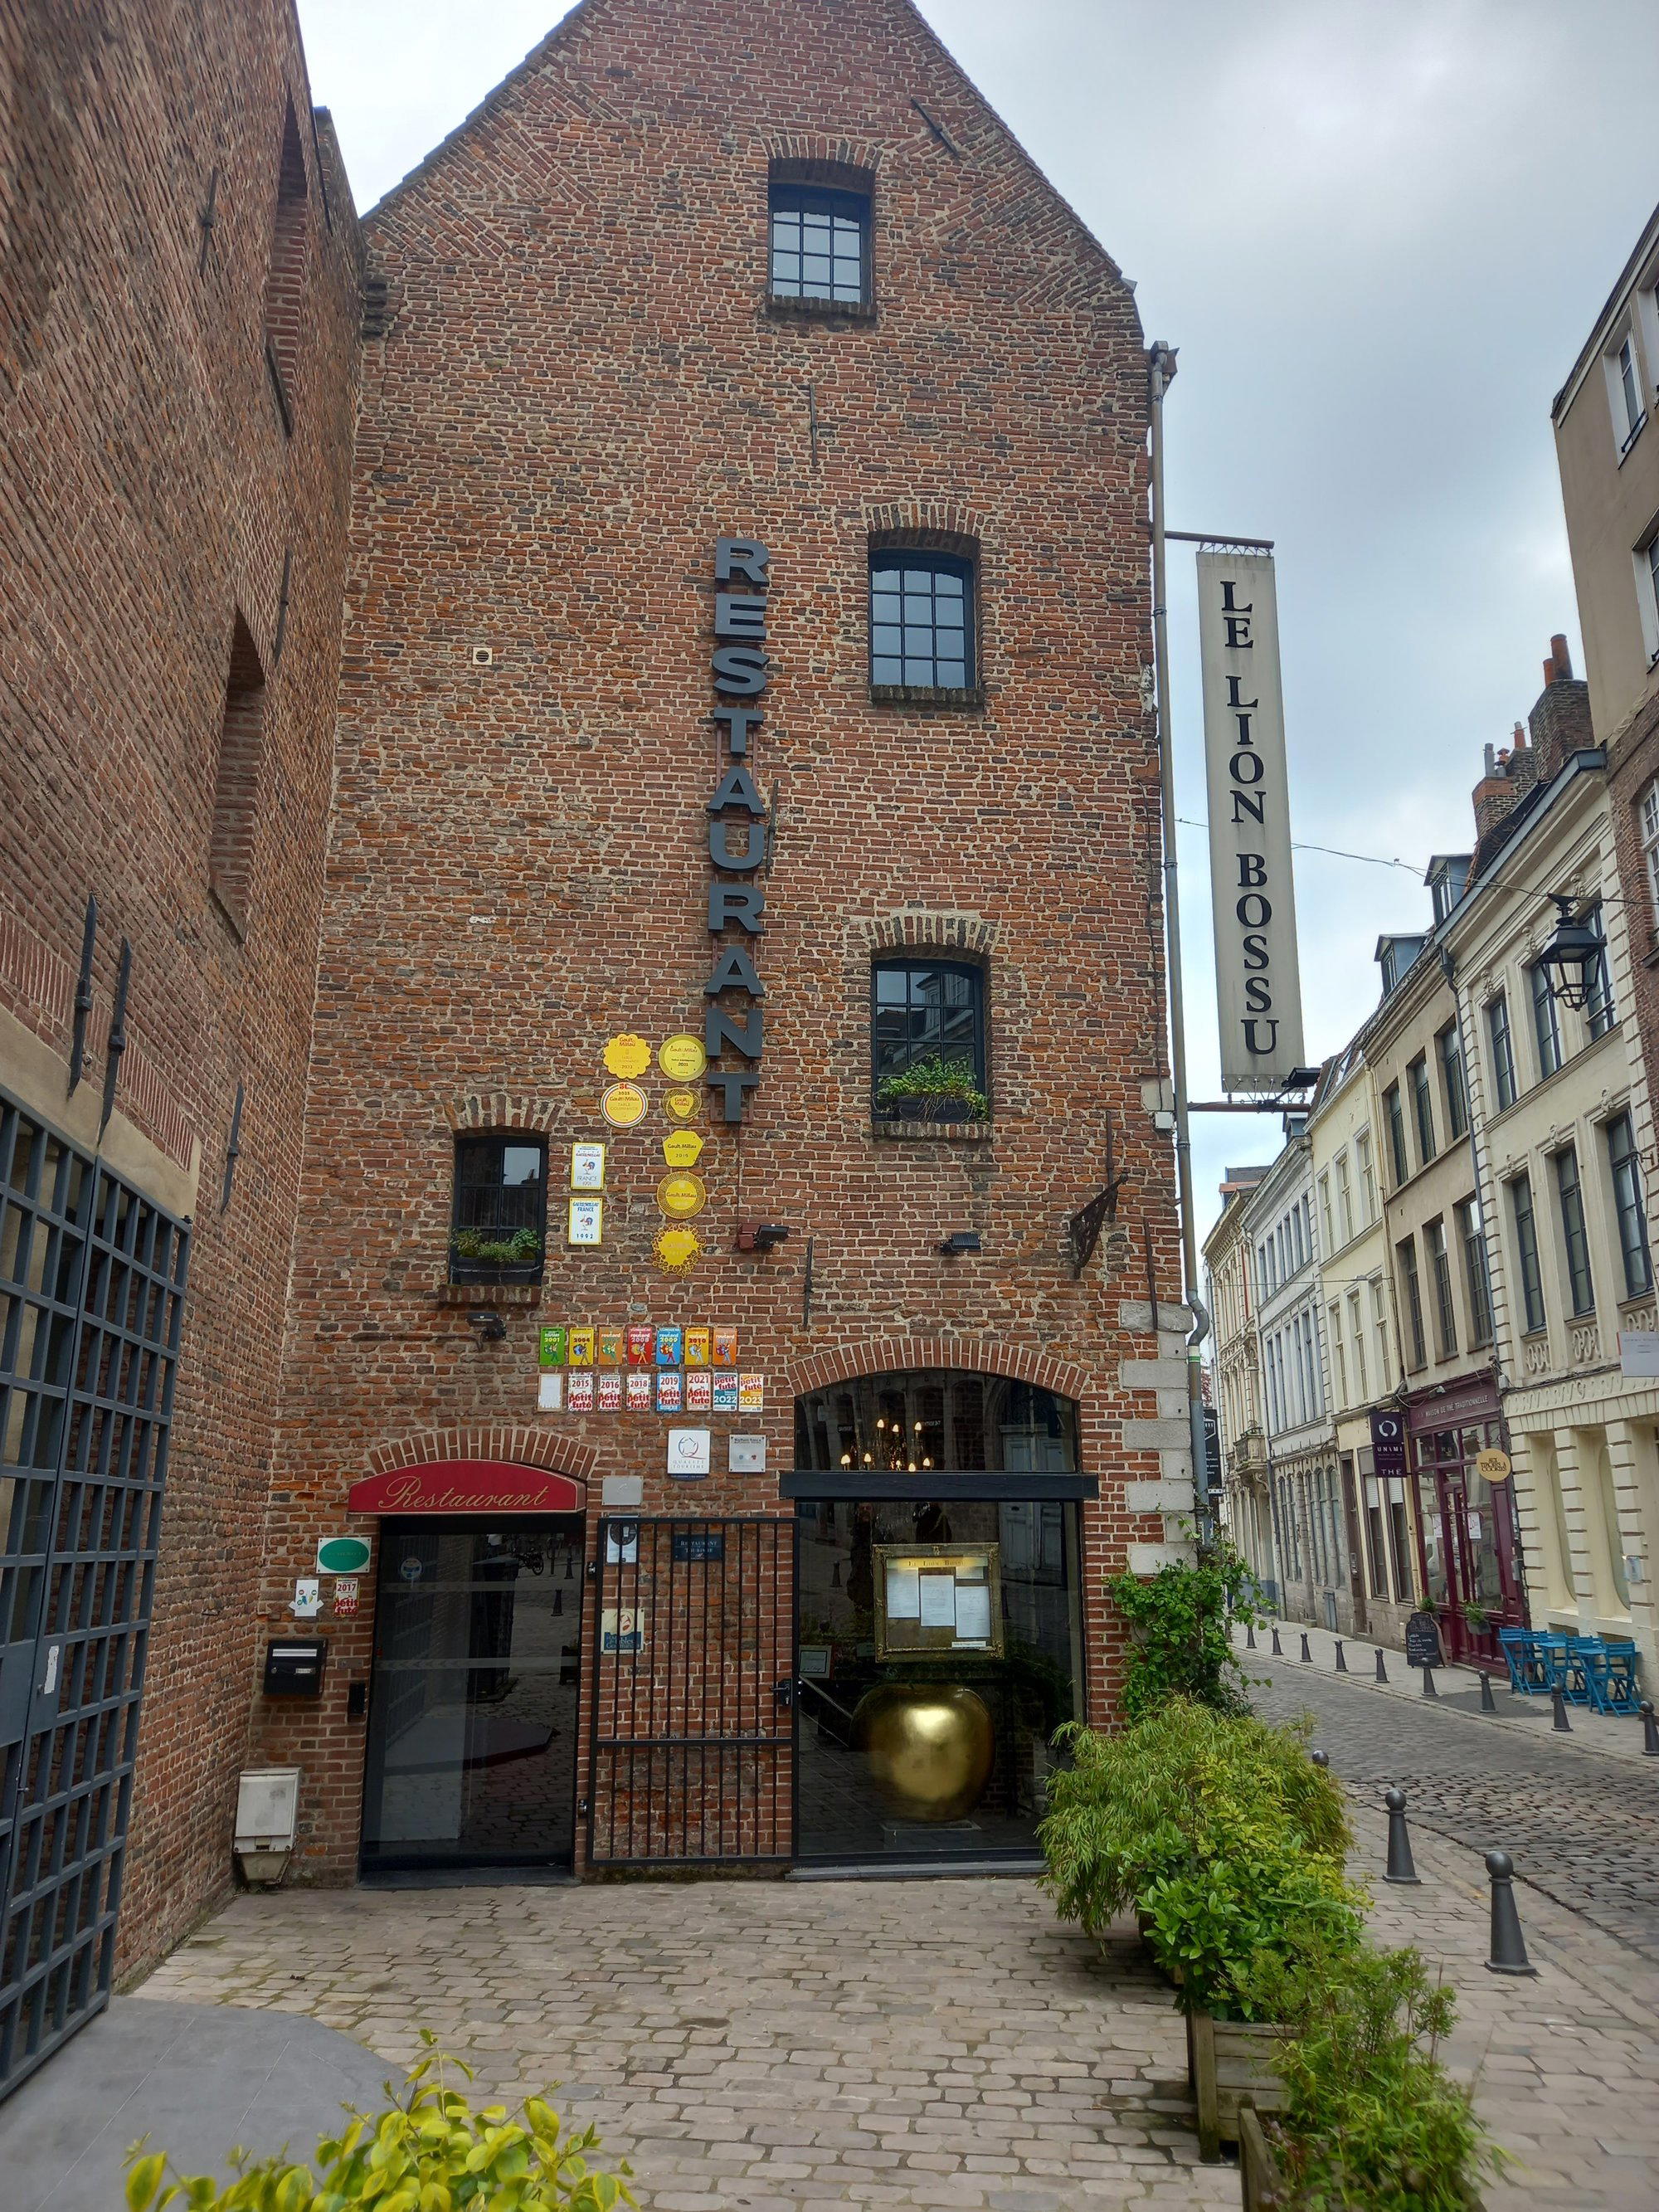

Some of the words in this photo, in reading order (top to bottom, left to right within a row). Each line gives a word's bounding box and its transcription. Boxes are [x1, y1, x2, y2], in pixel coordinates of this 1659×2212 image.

[1220, 581, 1254, 648] LE
[1224, 675, 1267, 824] LION
[703, 536, 770, 1123] RESTAURANT
[1236, 853, 1279, 1055] BOSSU
[688, 1376, 708, 1384] 2021
[714, 1376, 735, 1386] petit
[740, 1376, 761, 1387] petit
[569, 1393, 592, 1403] petit
[597, 1393, 621, 1404] petit
[626, 1393, 650, 1404] petit
[658, 1390, 680, 1400] petit
[688, 1390, 710, 1399] petit
[713, 1396, 737, 1404] 2022
[740, 1396, 762, 1404] 2023
[378, 1475, 549, 1509] Restaurant
[338, 1583, 357, 1592] 2017
[333, 1599, 359, 1609] petit
